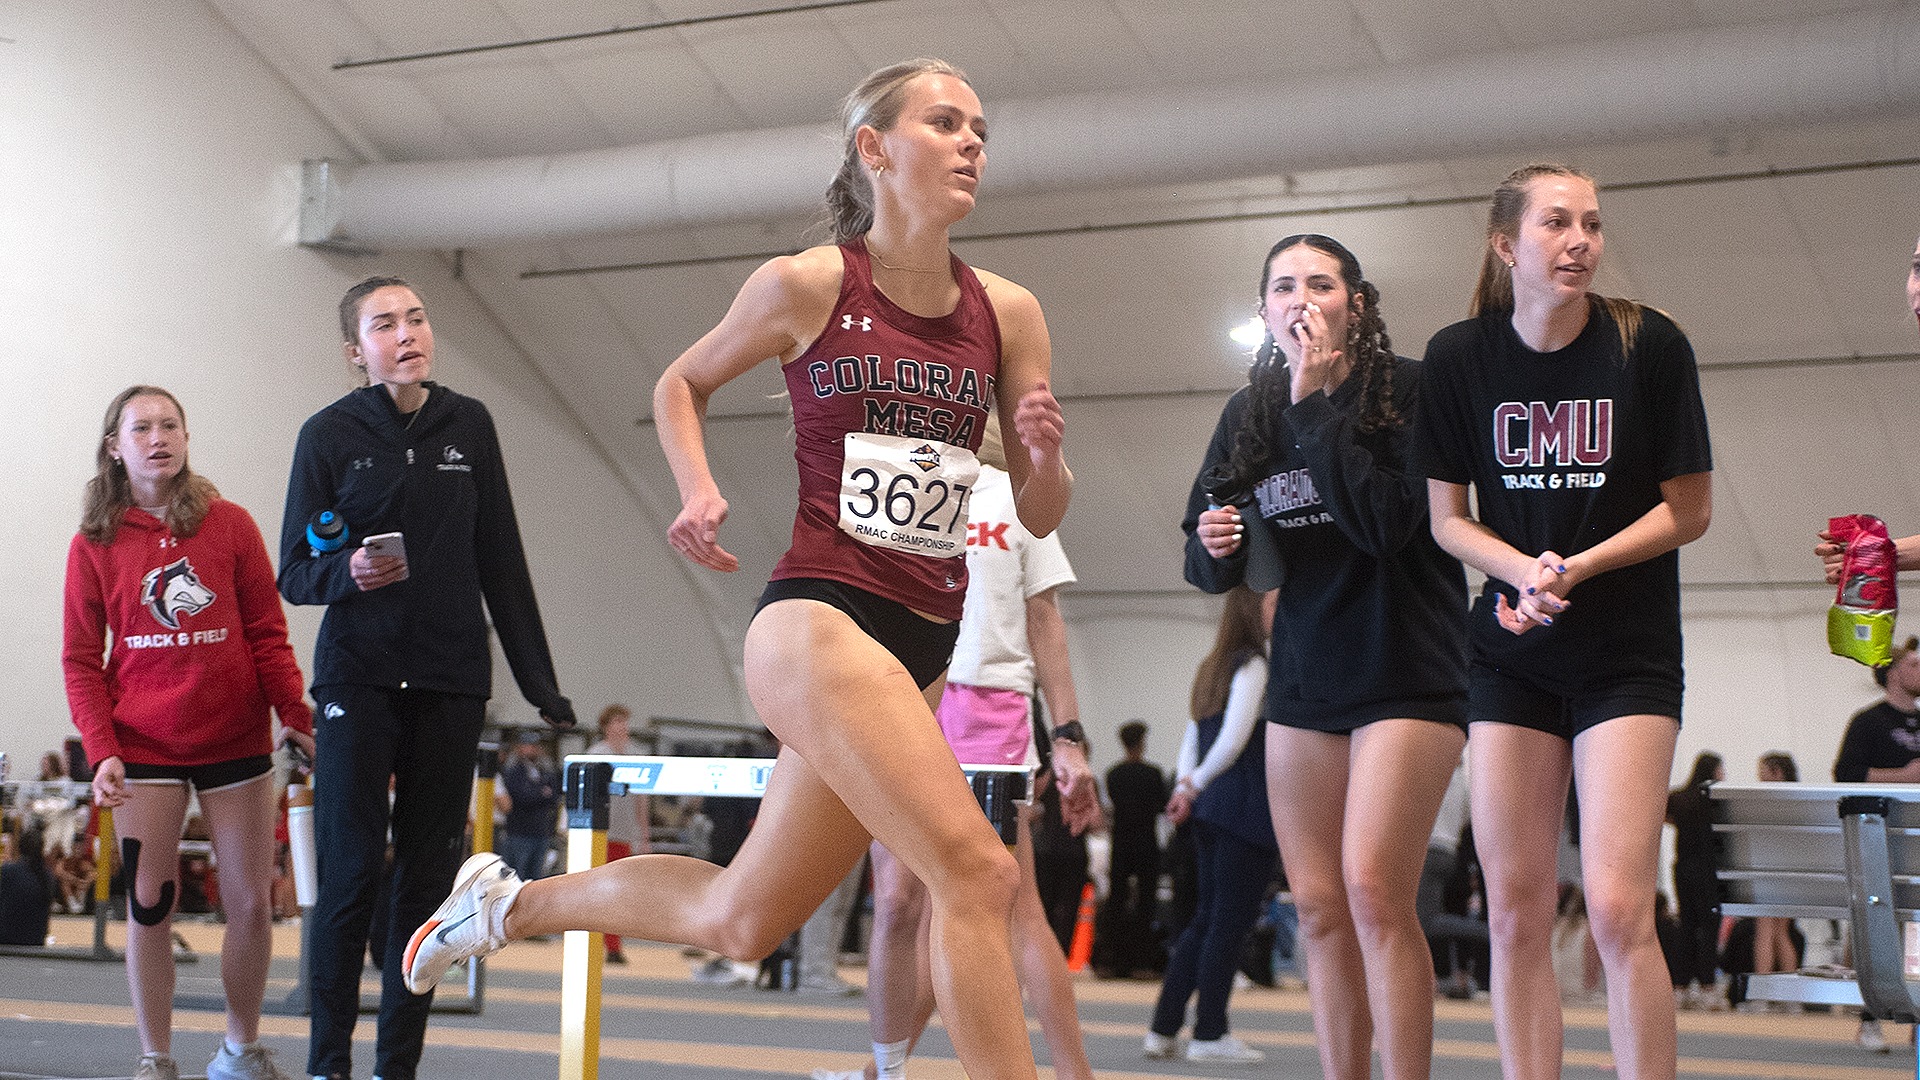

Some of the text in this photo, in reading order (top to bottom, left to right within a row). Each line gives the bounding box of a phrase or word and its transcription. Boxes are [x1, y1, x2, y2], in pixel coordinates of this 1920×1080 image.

[807, 354, 996, 414] COLORA
[863, 397, 976, 449] MESA
[1493, 398, 1614, 468] CMU
[846, 467, 973, 535] 3627
[1501, 472, 1607, 490] TRACK & FIELD
[855, 524, 956, 552] RMAC CHAMPIONSHIP
[1276, 515, 1310, 529] TRACK
[1309, 514, 1320, 525] &
[123, 627, 229, 650] TRACK & FIELD
